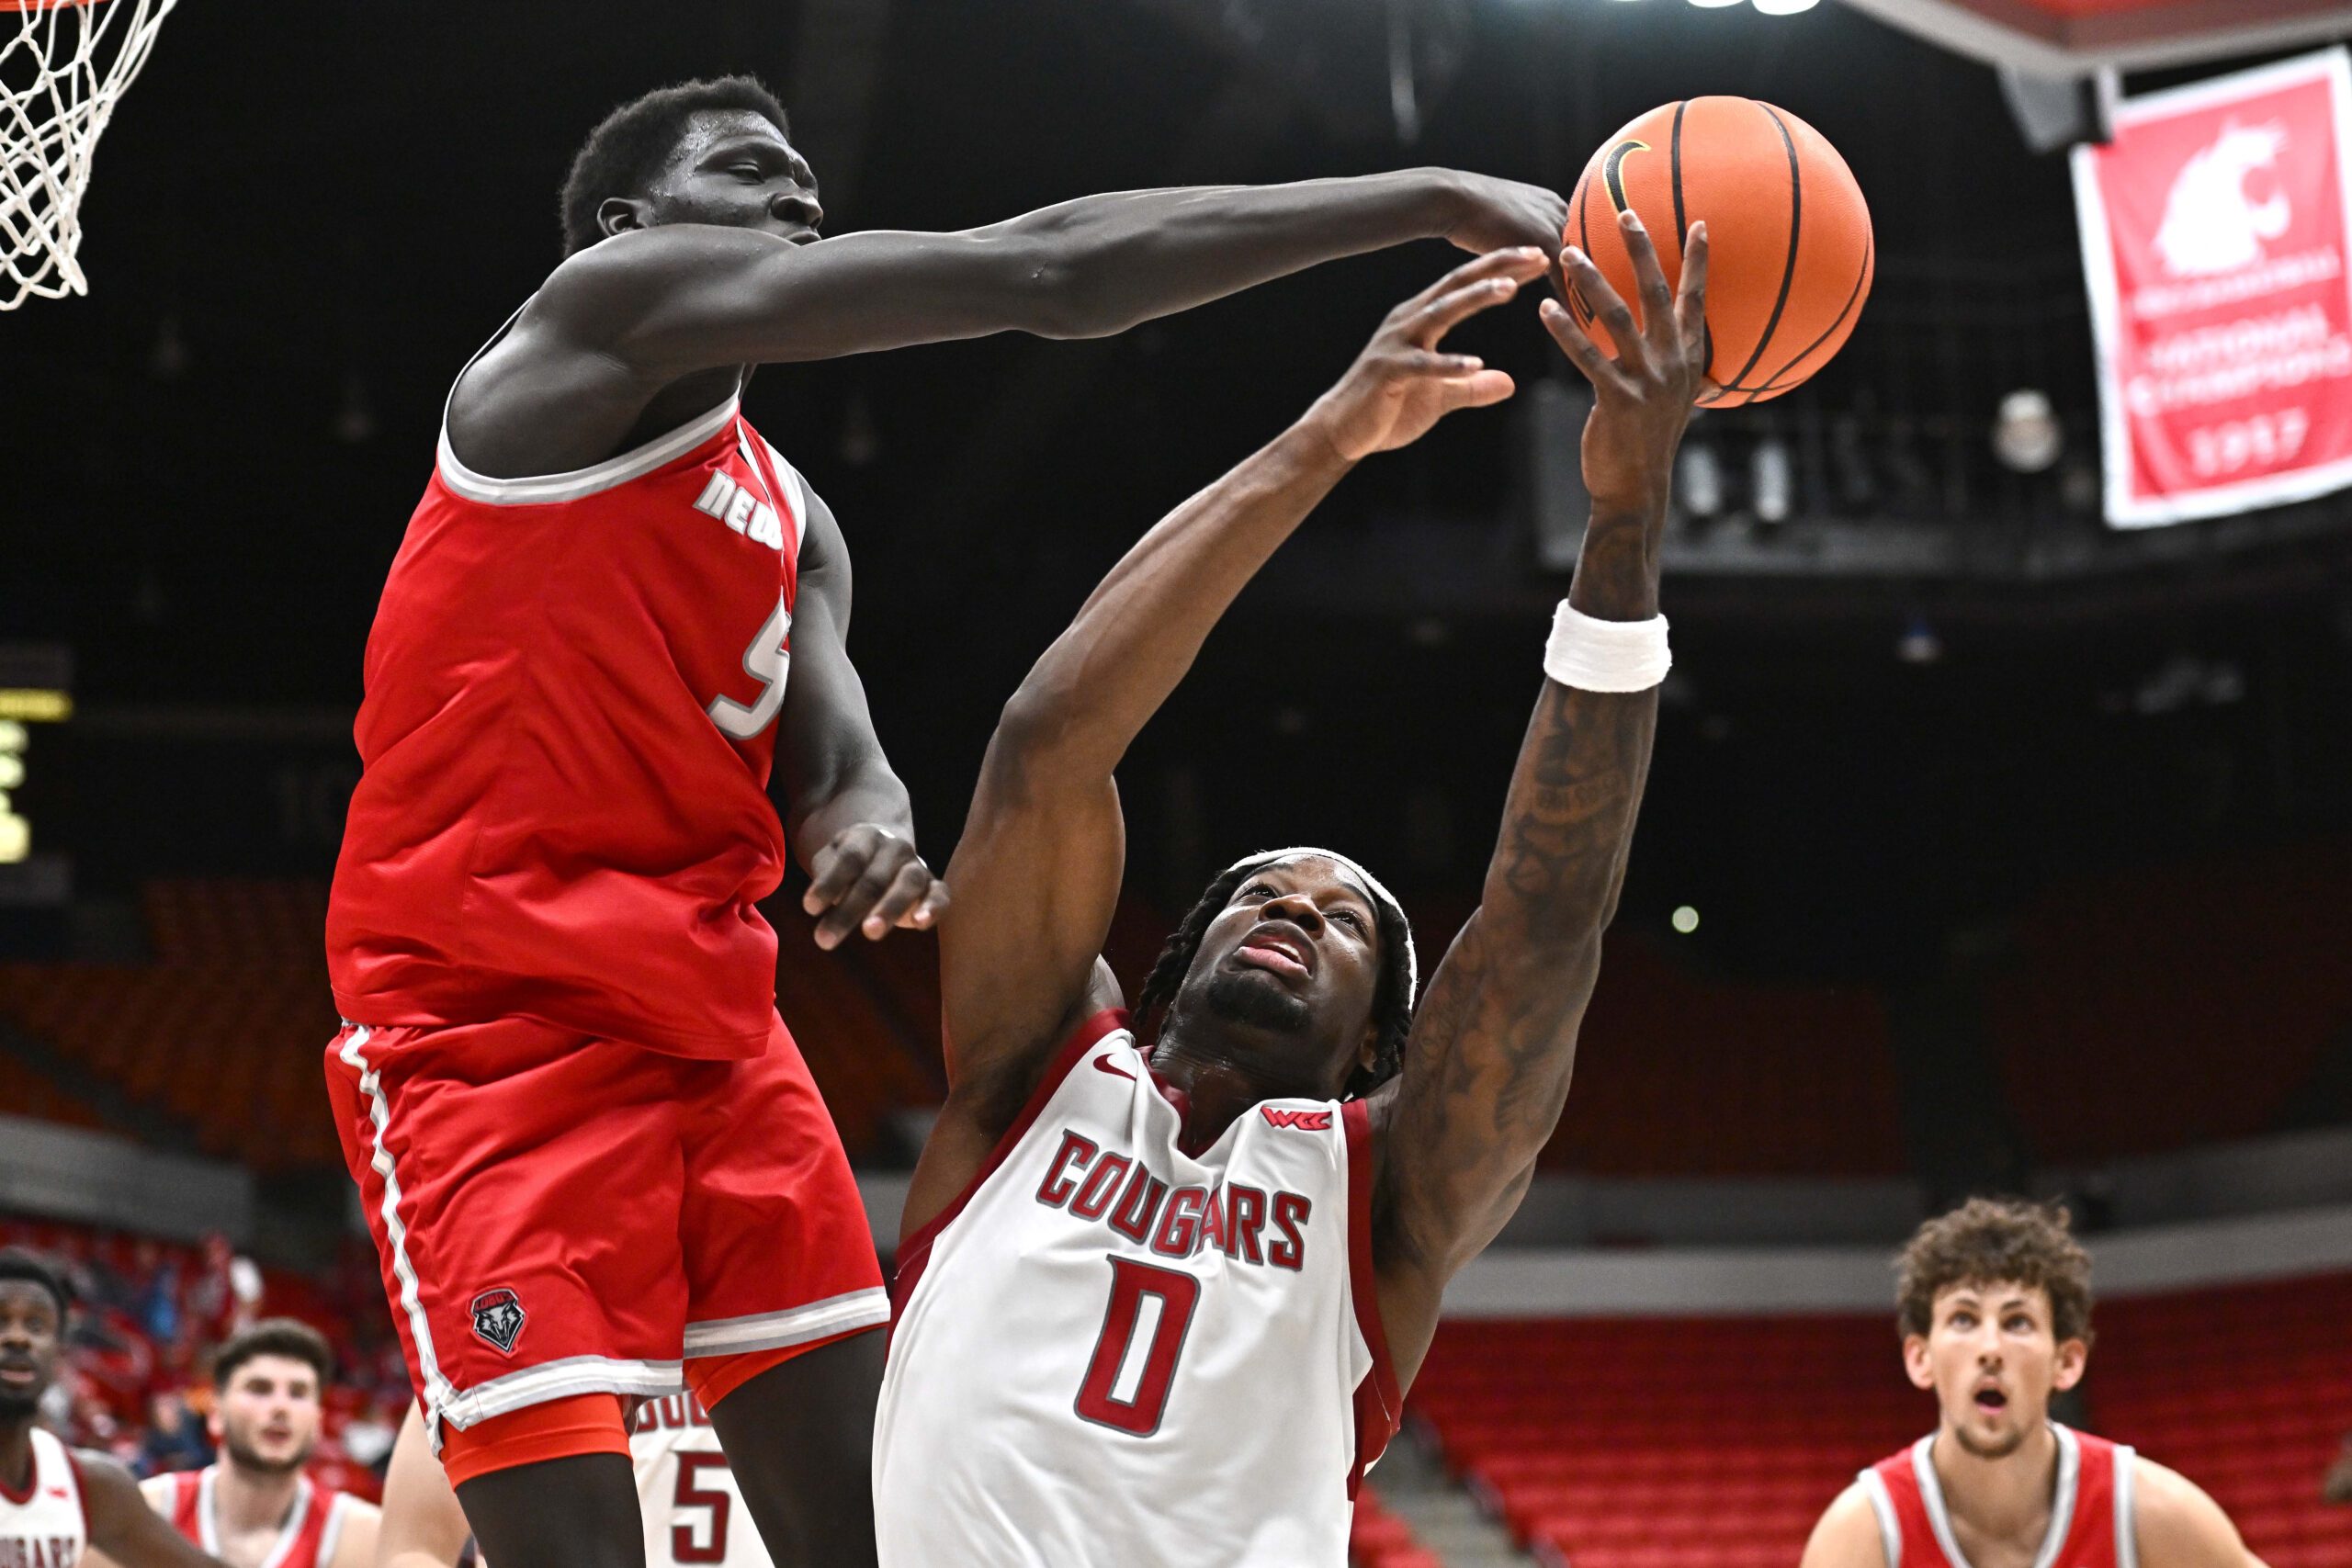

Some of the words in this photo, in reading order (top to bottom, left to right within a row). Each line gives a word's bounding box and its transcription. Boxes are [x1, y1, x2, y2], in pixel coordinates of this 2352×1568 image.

[706, 586, 790, 739] 5
[1260, 1105, 1332, 1131] WCC
[1035, 1128, 1312, 1271] COUGARS
[1073, 1254, 1201, 1438] 0
[670, 1450, 732, 1564] 5
